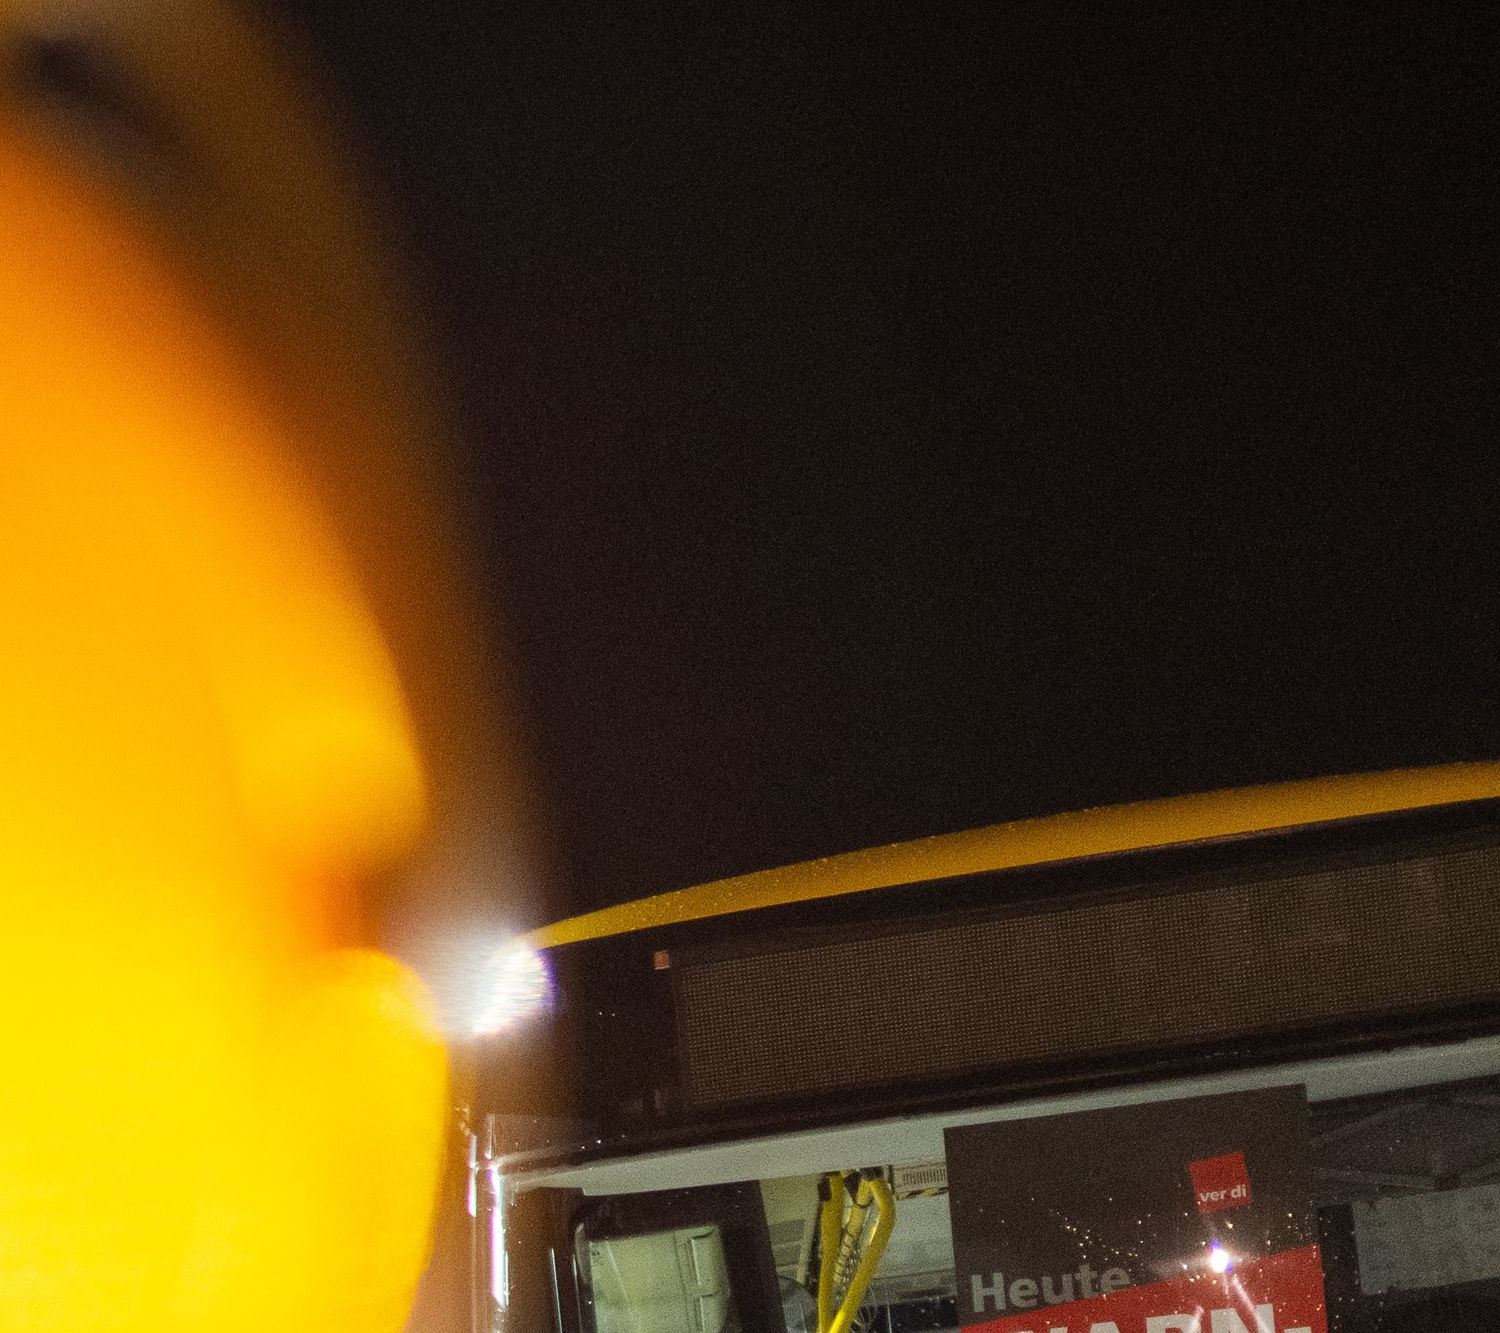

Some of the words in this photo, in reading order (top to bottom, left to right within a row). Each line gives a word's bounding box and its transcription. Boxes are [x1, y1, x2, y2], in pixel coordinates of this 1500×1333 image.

[1199, 1189, 1226, 1202] ver
[1230, 1184, 1246, 1199] di
[970, 1264, 1131, 1313] Heute
